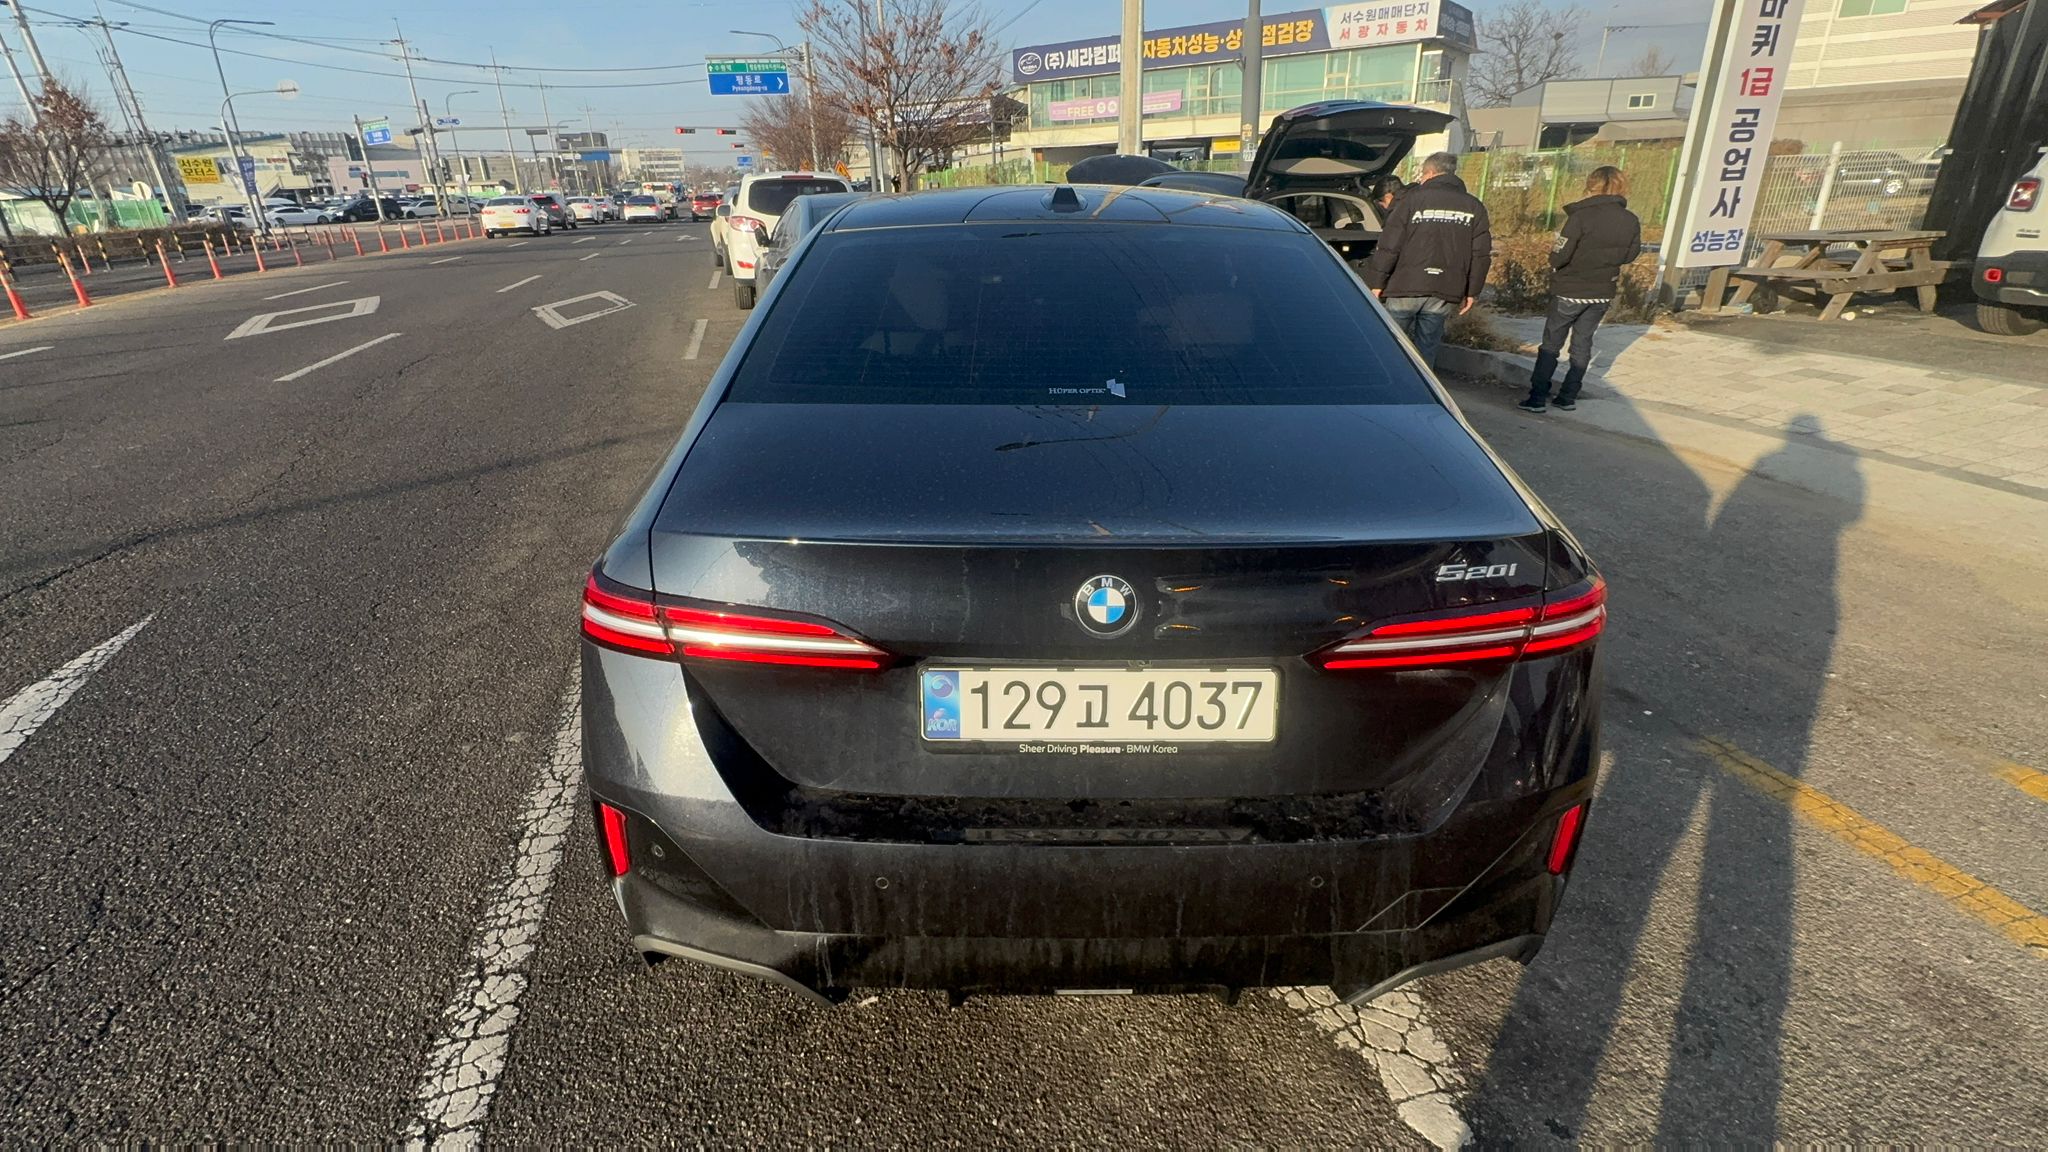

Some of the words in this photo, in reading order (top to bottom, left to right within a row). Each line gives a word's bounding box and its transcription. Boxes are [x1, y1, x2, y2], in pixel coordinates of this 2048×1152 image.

[1340, 2, 1430, 25] 서수원매매단지
[735, 75, 762, 86] 평동로
[1739, 67, 1774, 96] 1급
[1067, 105, 1095, 117] FREE
[181, 158, 213, 168] 서수원
[1709, 108, 1761, 218] 공업사
[183, 168, 216, 177] 모터스
[1411, 209, 1475, 223] ASSERT
[1690, 228, 1744, 253] 성능장
[1436, 563, 1518, 582] 520i
[970, 680, 1109, 730] 129고
[1127, 680, 1263, 730] 4037
[926, 718, 957, 732] KOR
[1019, 743, 1046, 753] Sheer
[1047, 744, 1078, 755] Driving
[1126, 744, 1151, 753] BMW
[1152, 744, 1178, 753] Korea
